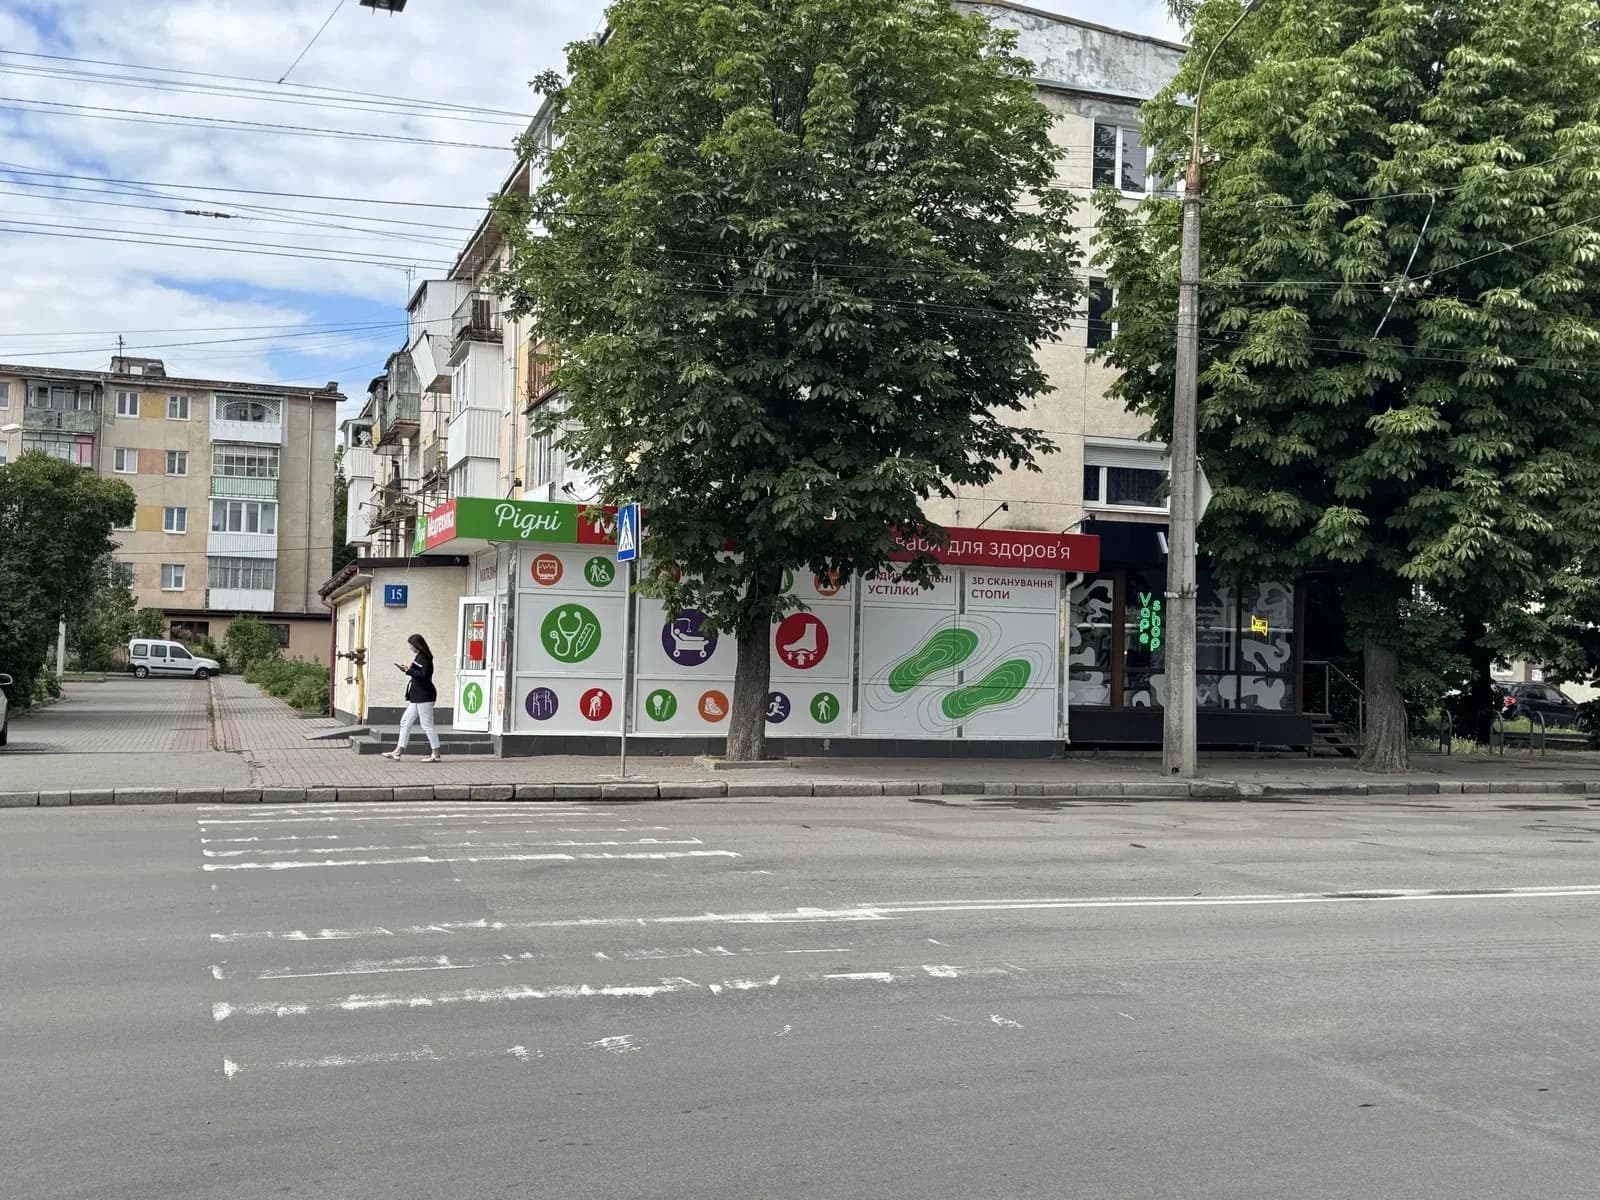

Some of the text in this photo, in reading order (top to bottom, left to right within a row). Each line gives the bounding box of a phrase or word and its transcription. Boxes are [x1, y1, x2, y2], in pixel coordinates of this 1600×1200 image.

[495, 503, 561, 538] Рідні
[947, 540, 983, 557] для
[988, 540, 1070, 562] здоров’я
[868, 584, 919, 596] УСТІЛКИ
[971, 576, 1053, 589] 3D СКАНУВАННЯ
[391, 588, 403, 600] 15
[971, 589, 1010, 600] СТОПИ
[1139, 591, 1152, 645] Vape
[1151, 599, 1161, 652] shop
